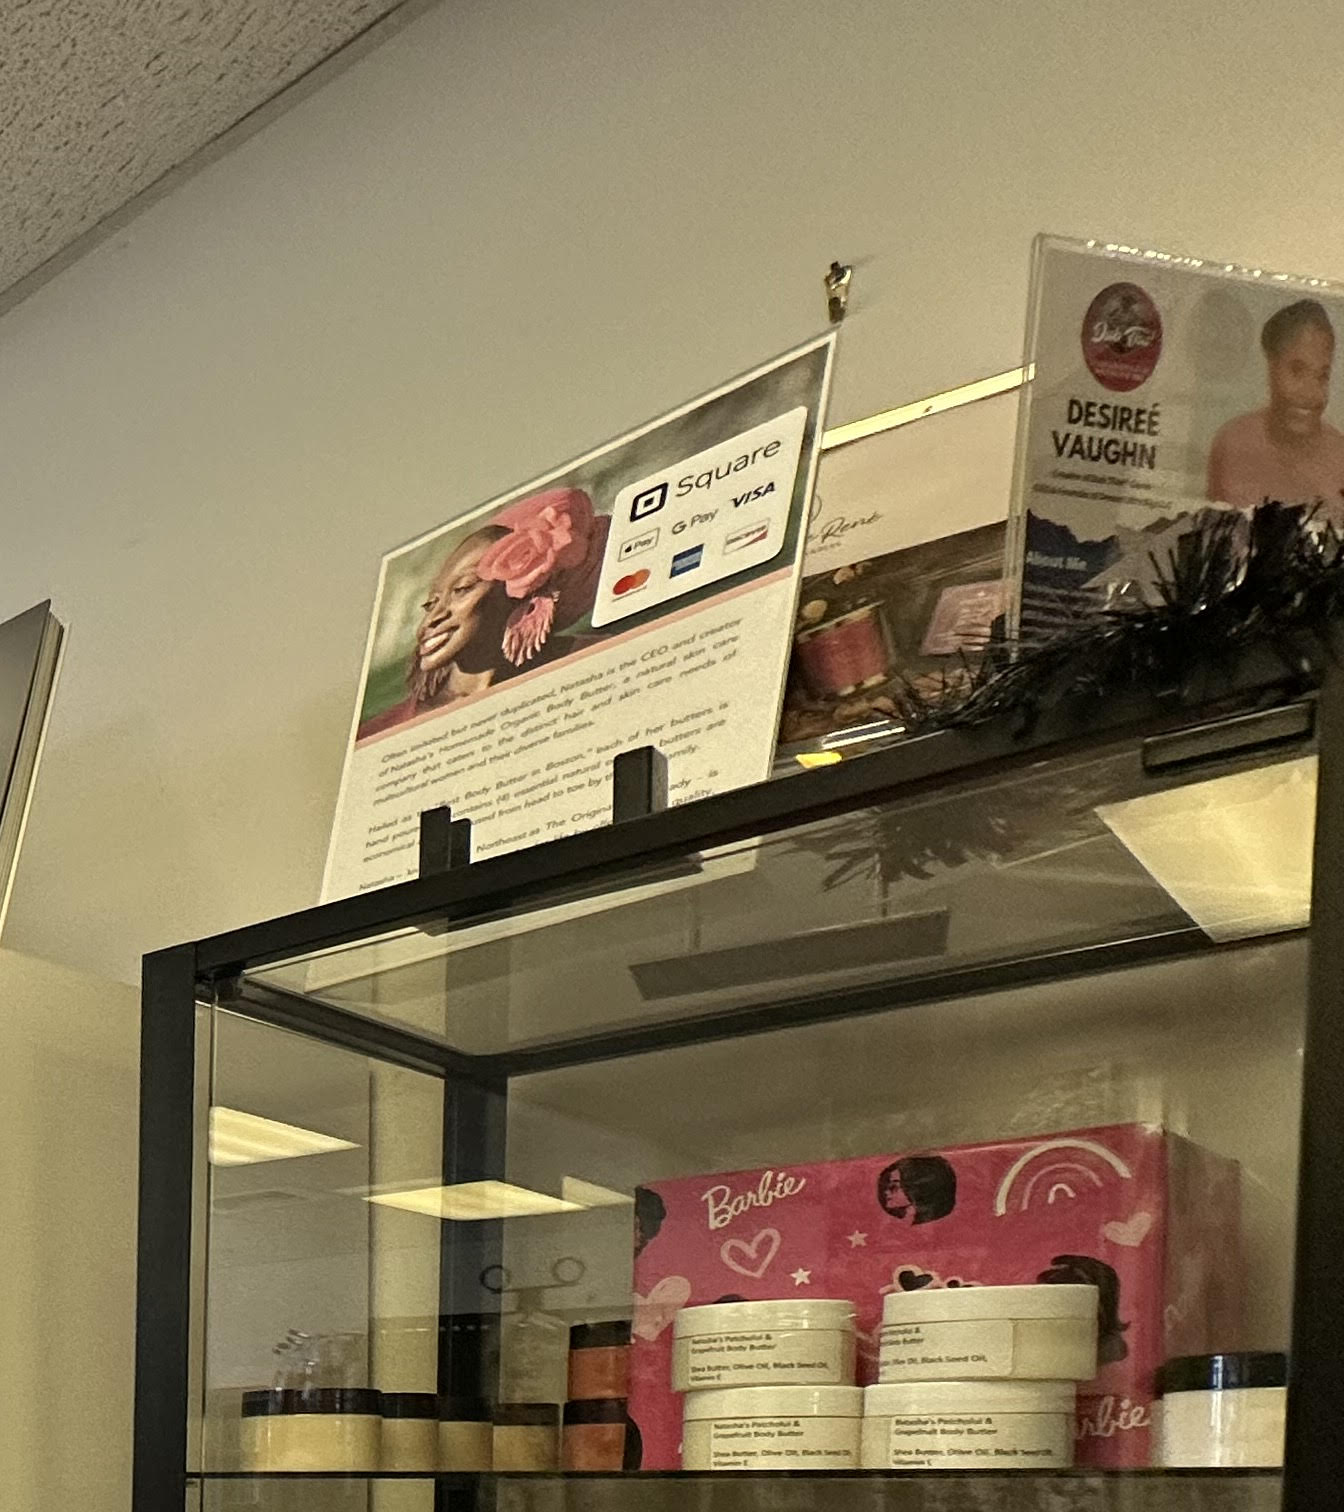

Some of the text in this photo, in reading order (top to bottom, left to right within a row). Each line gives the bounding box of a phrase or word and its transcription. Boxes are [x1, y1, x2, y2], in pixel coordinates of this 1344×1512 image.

[1067, 399, 1162, 437] DESIREÉ
[1051, 431, 1157, 470] VAUGHN
[675, 439, 781, 497] Square
[730, 482, 776, 508] VISA
[671, 508, 719, 535] G Pay
[633, 535, 655, 550] Pay
[560, 671, 604, 693] Natasha
[619, 659, 637, 671] the
[640, 645, 669, 662] CEO
[672, 634, 696, 650] and
[647, 676, 673, 689] care
[679, 659, 717, 678] needs
[500, 711, 540, 730] Organic
[546, 698, 573, 713] Body
[636, 656, 677, 679] natural
[712, 636, 739, 650] care
[465, 706, 713, 800] Body Butter butters
[431, 767, 465, 784] women
[700, 1170, 807, 1230] Barbie
[748, 1342, 776, 1352] Butter
[732, 1362, 795, 1372] Olive Black
[778, 1429, 804, 1438] Butter
[1073, 1396, 1152, 1441] rbie
